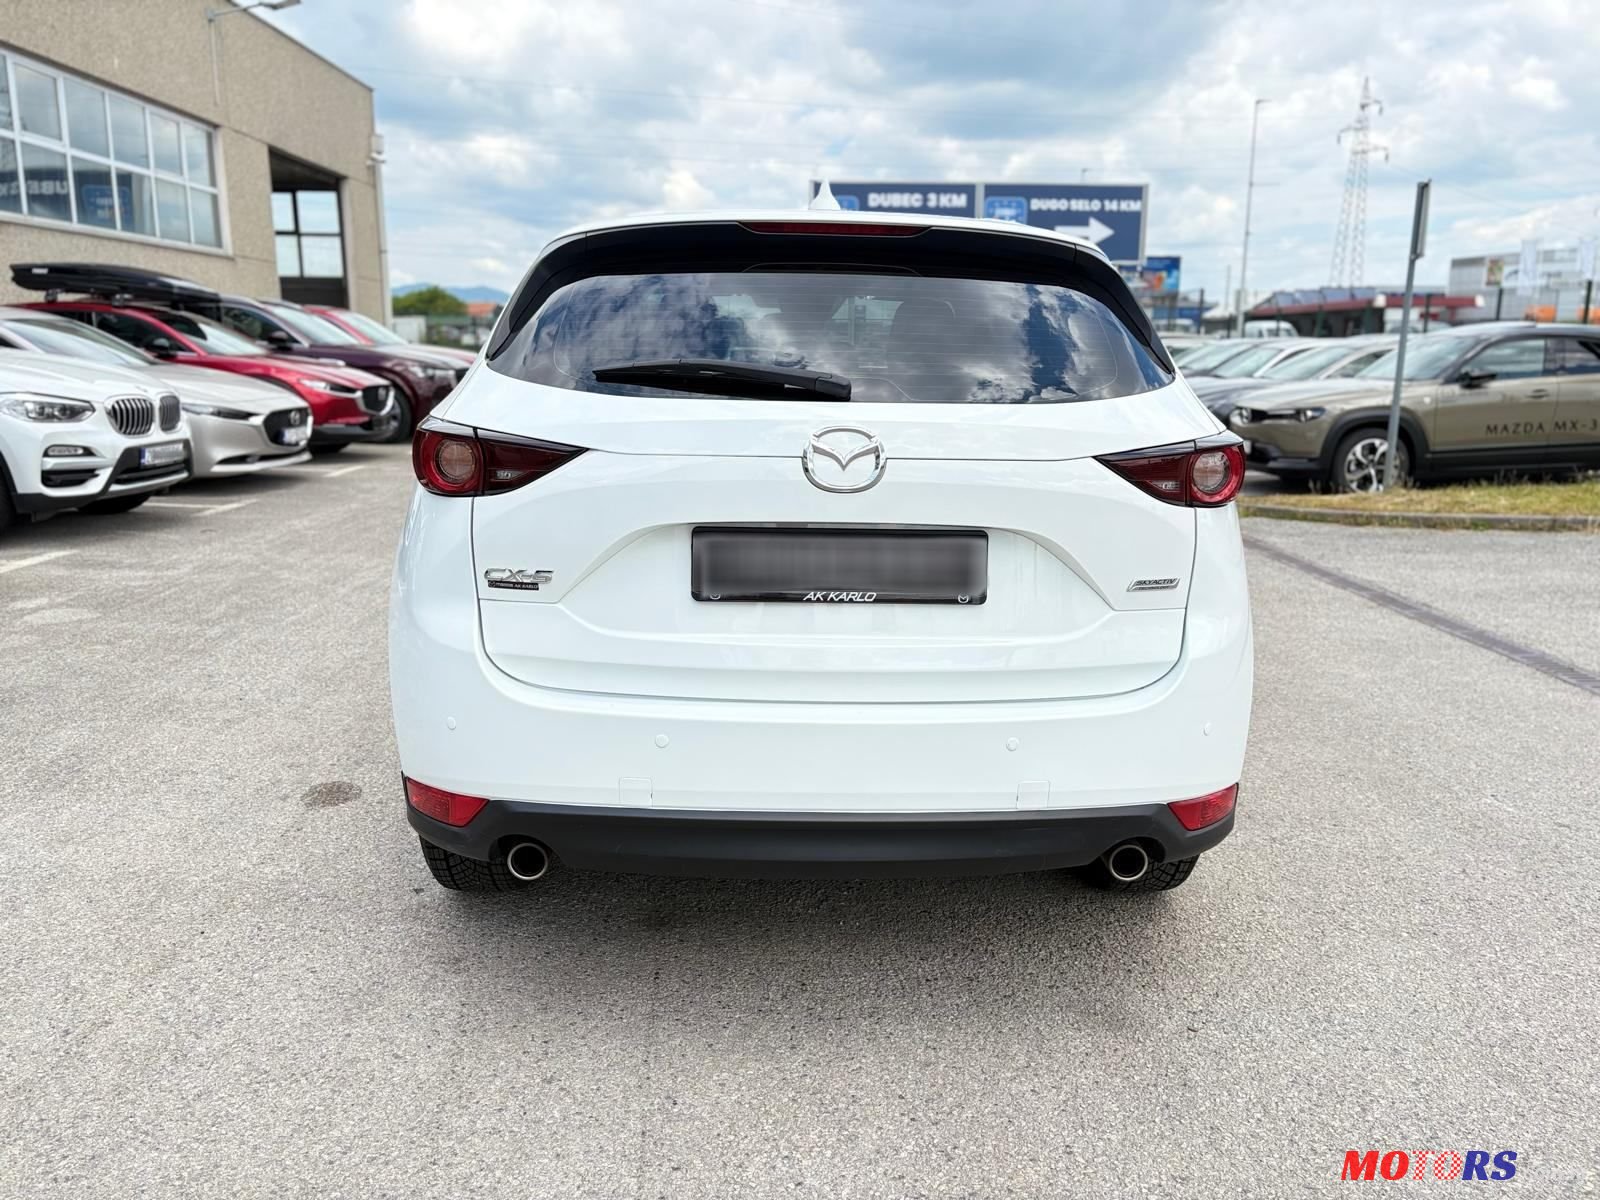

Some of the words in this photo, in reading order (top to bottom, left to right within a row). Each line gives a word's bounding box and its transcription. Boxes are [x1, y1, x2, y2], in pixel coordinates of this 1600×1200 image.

[867, 192, 924, 208] DUBEC
[926, 192, 938, 208] 3
[939, 193, 968, 208] KM
[1030, 198, 1069, 211] DUGO
[1069, 198, 1102, 212] SELO
[1103, 199, 1118, 212] 14
[1119, 200, 1142, 212] KM
[1486, 422, 1546, 435] MAZDA
[484, 568, 554, 584] CX-5
[1135, 578, 1177, 586] SKYACTIV
[803, 591, 827, 601] AK
[827, 591, 877, 602] KARLO
